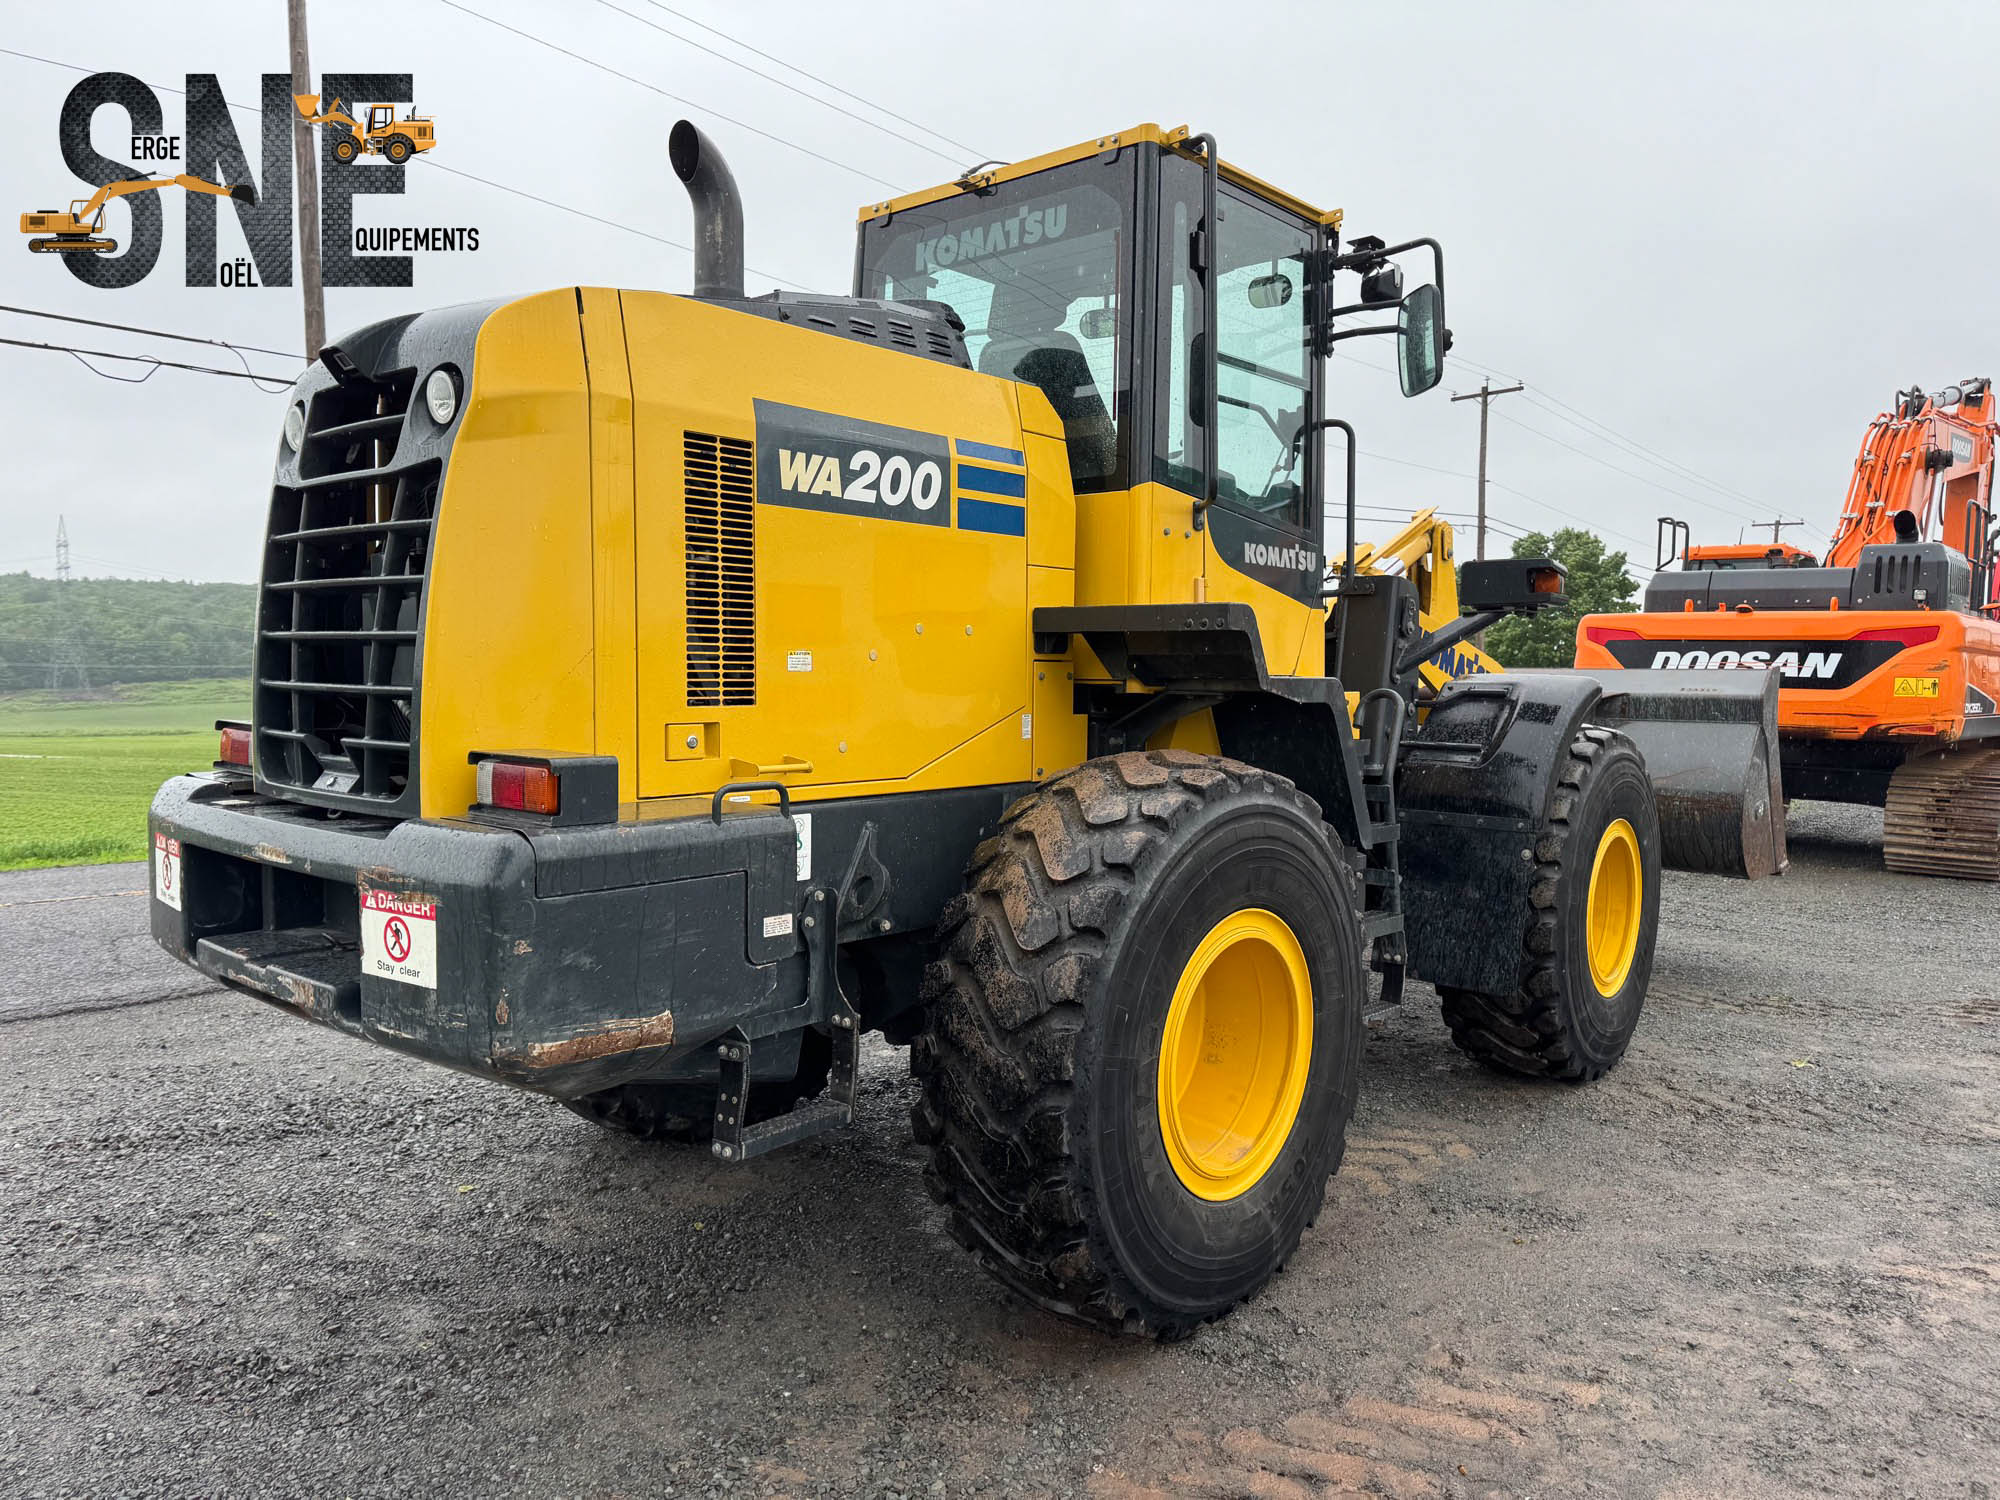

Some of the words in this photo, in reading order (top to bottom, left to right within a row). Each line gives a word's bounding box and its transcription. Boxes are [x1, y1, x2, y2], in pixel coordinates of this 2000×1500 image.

[915, 203, 1068, 273] KOMATSU
[778, 448, 942, 511] WA200
[1244, 541, 1316, 572] KOMATSU
[1651, 650, 1842, 678] DOOSAN
[378, 893, 431, 917] DANGER
[377, 960, 395, 975] Stay
[399, 965, 421, 978] clear
